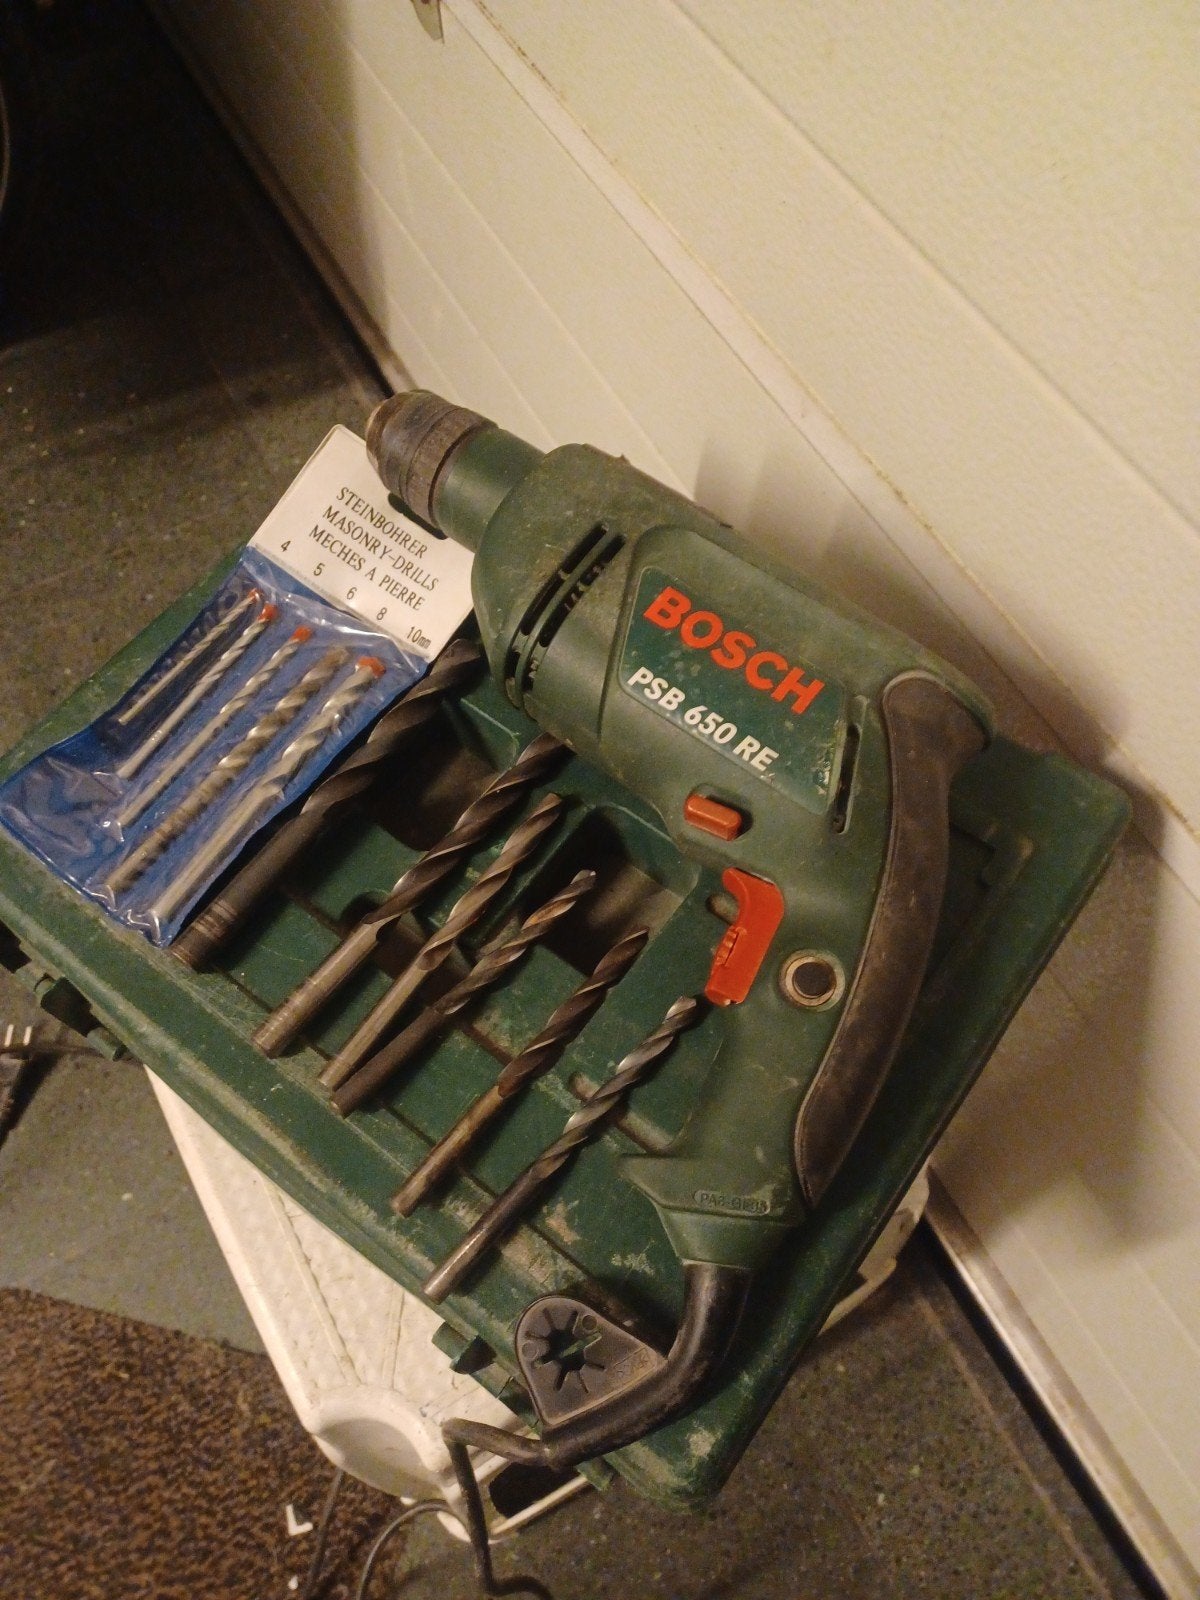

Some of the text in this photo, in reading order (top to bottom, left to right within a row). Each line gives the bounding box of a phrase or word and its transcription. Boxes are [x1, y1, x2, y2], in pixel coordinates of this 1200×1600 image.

[309, 524, 426, 611] MECHES A PIERRE
[322, 505, 439, 592] MASONRY-DRILLS
[336, 486, 428, 559] STEINBOHRER
[280, 540, 431, 650] 4 5 6 8 10mm
[643, 585, 826, 715] BOSCH
[627, 666, 779, 772] PSB 650 RE
